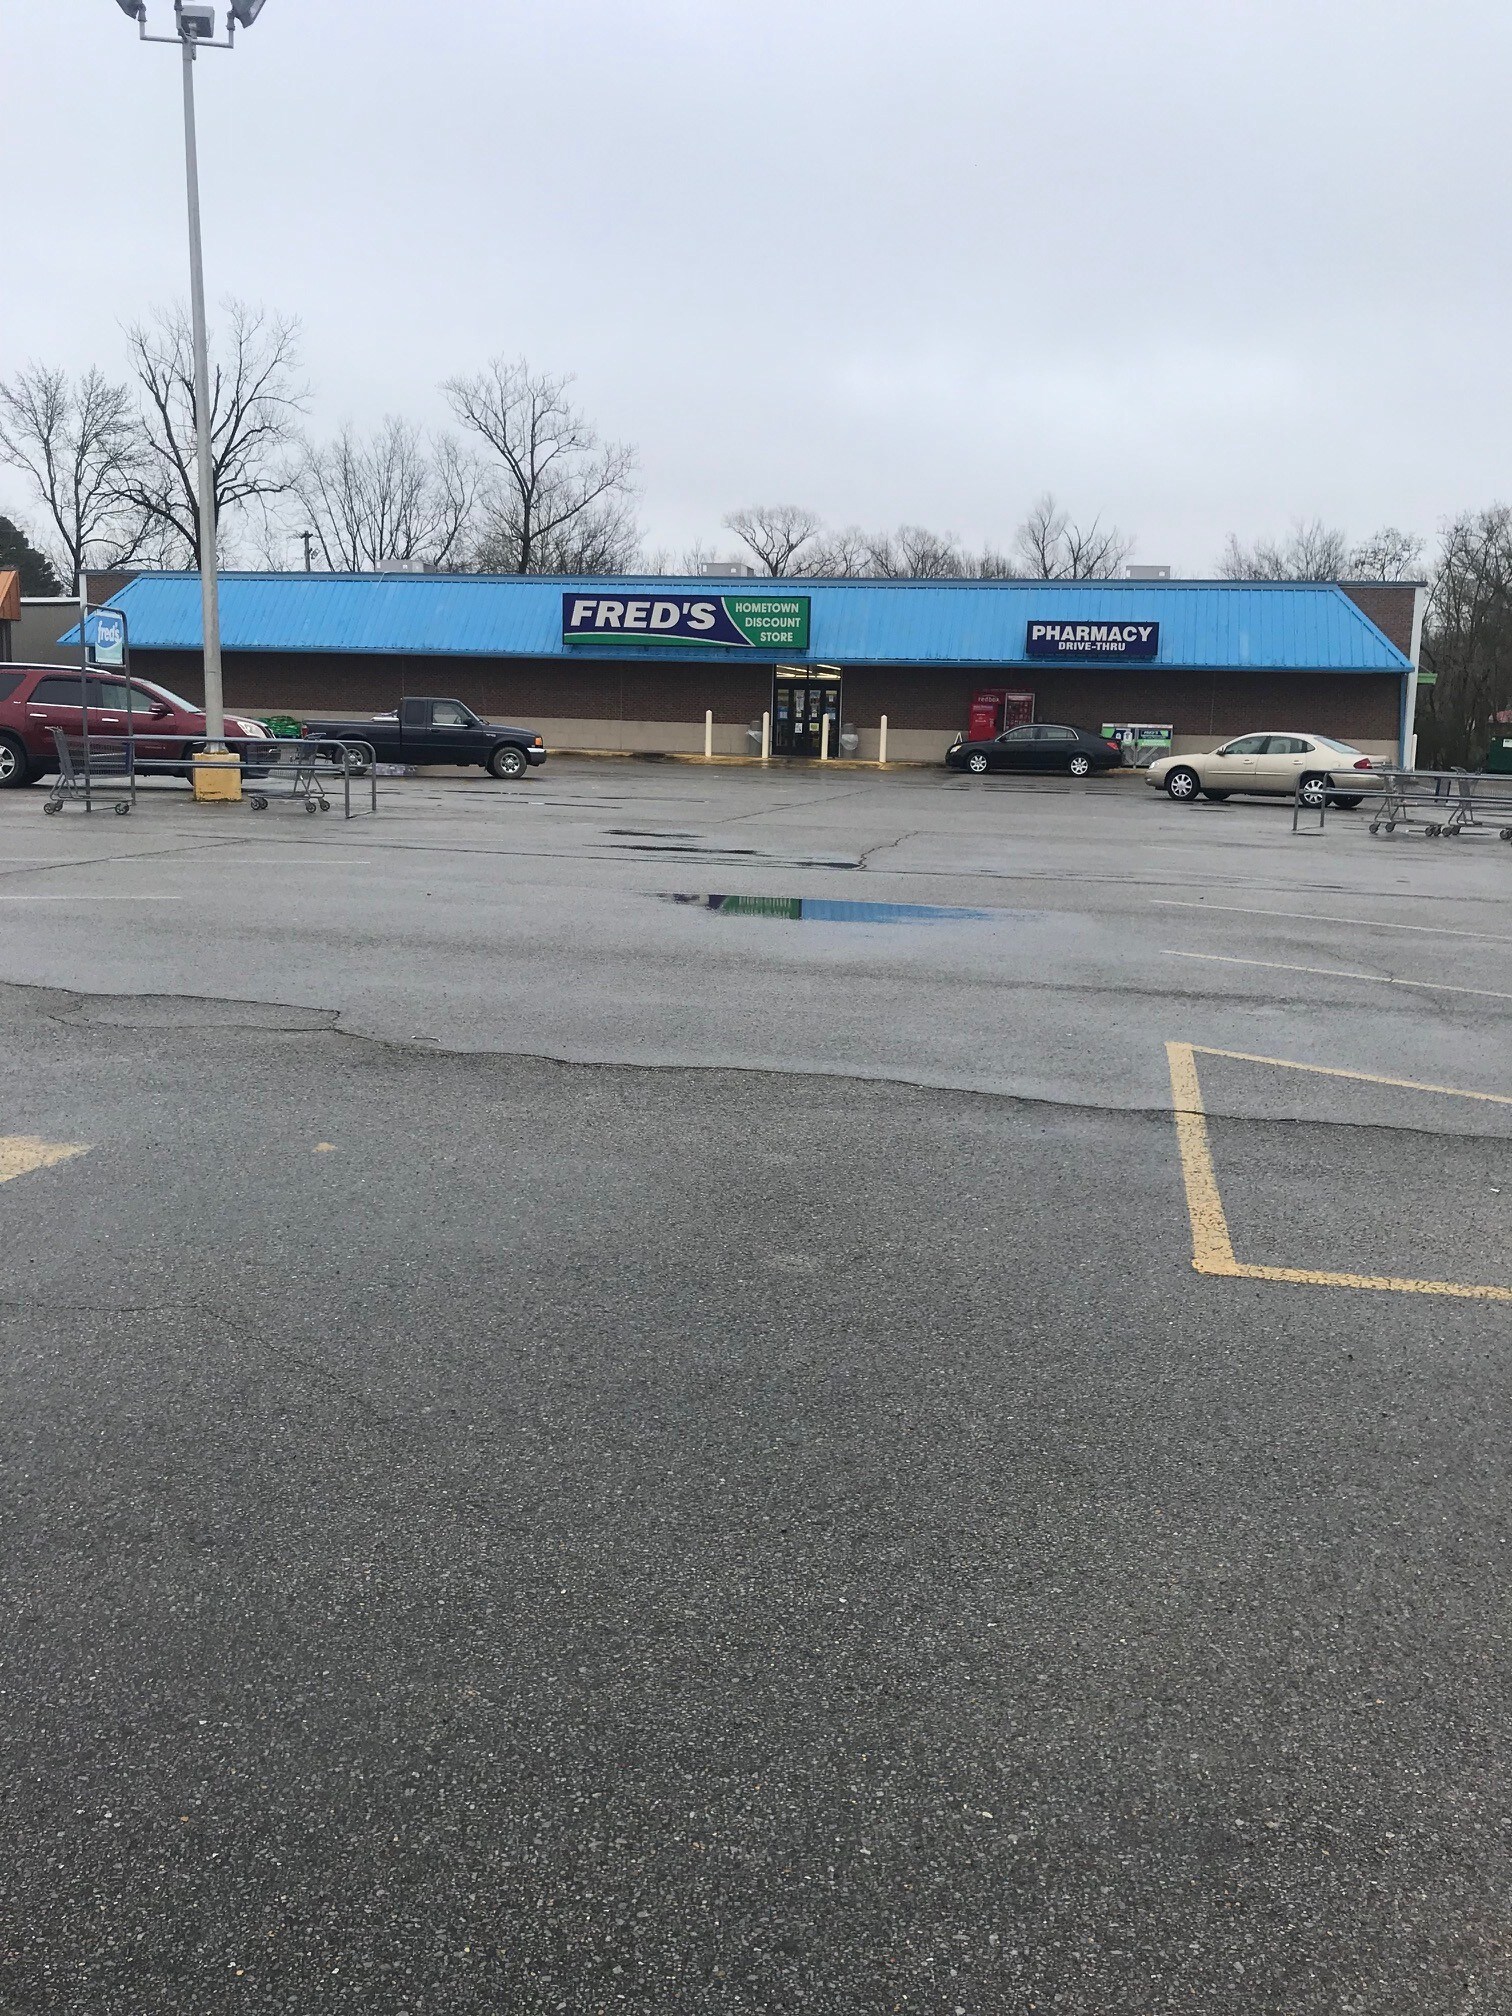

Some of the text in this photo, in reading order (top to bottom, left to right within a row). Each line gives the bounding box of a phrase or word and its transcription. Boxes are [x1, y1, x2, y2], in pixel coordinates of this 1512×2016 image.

[735, 602, 799, 613] HOMETOWN
[570, 600, 716, 630] FRED'S
[745, 617, 801, 628] DISCOUNT
[97, 620, 121, 644] fred's
[760, 631, 793, 642] STORE
[1032, 625, 1153, 642] PHARMACY
[1058, 641, 1126, 651] DRIVE-THRU
